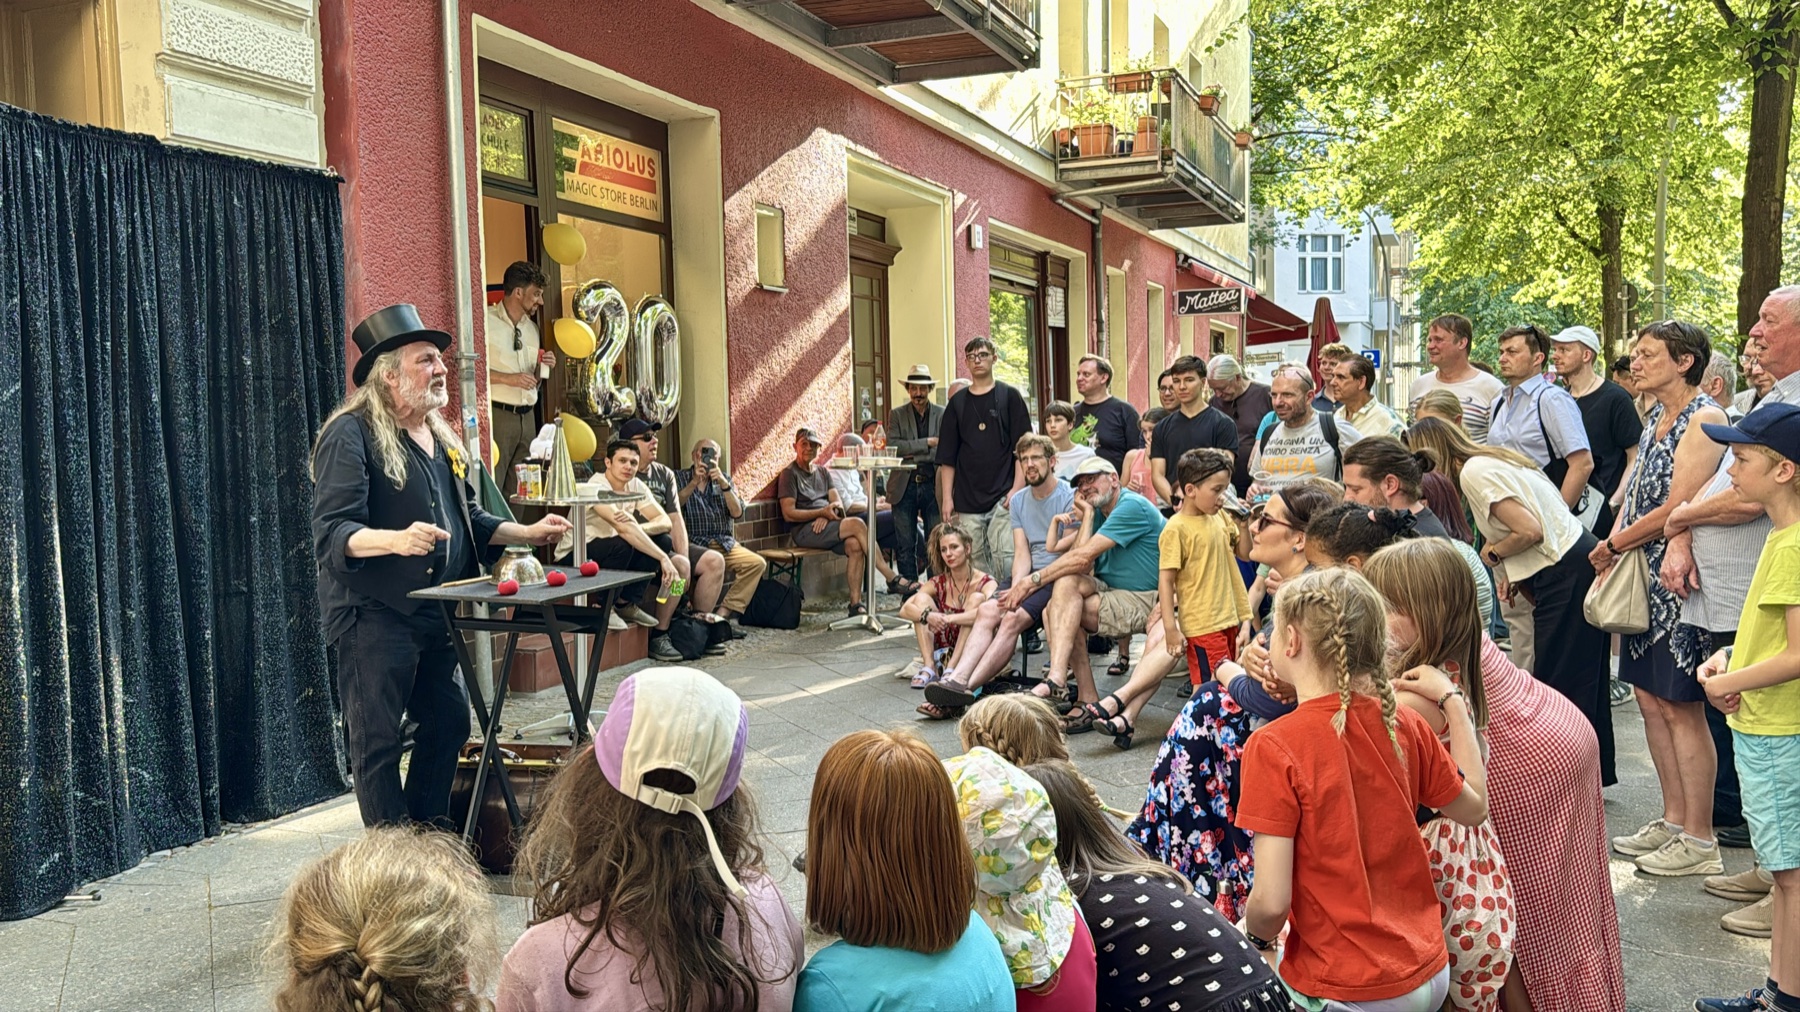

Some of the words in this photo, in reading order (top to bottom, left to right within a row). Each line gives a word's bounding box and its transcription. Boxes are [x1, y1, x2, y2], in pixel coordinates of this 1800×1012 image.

[566, 178, 597, 198] MAGIC
[599, 186, 628, 206] STORE
[629, 194, 658, 213] BERLIN
[1179, 289, 1239, 314] Mattea
[1309, 437, 1325, 446] UN
[1289, 446, 1321, 455] SENZA
